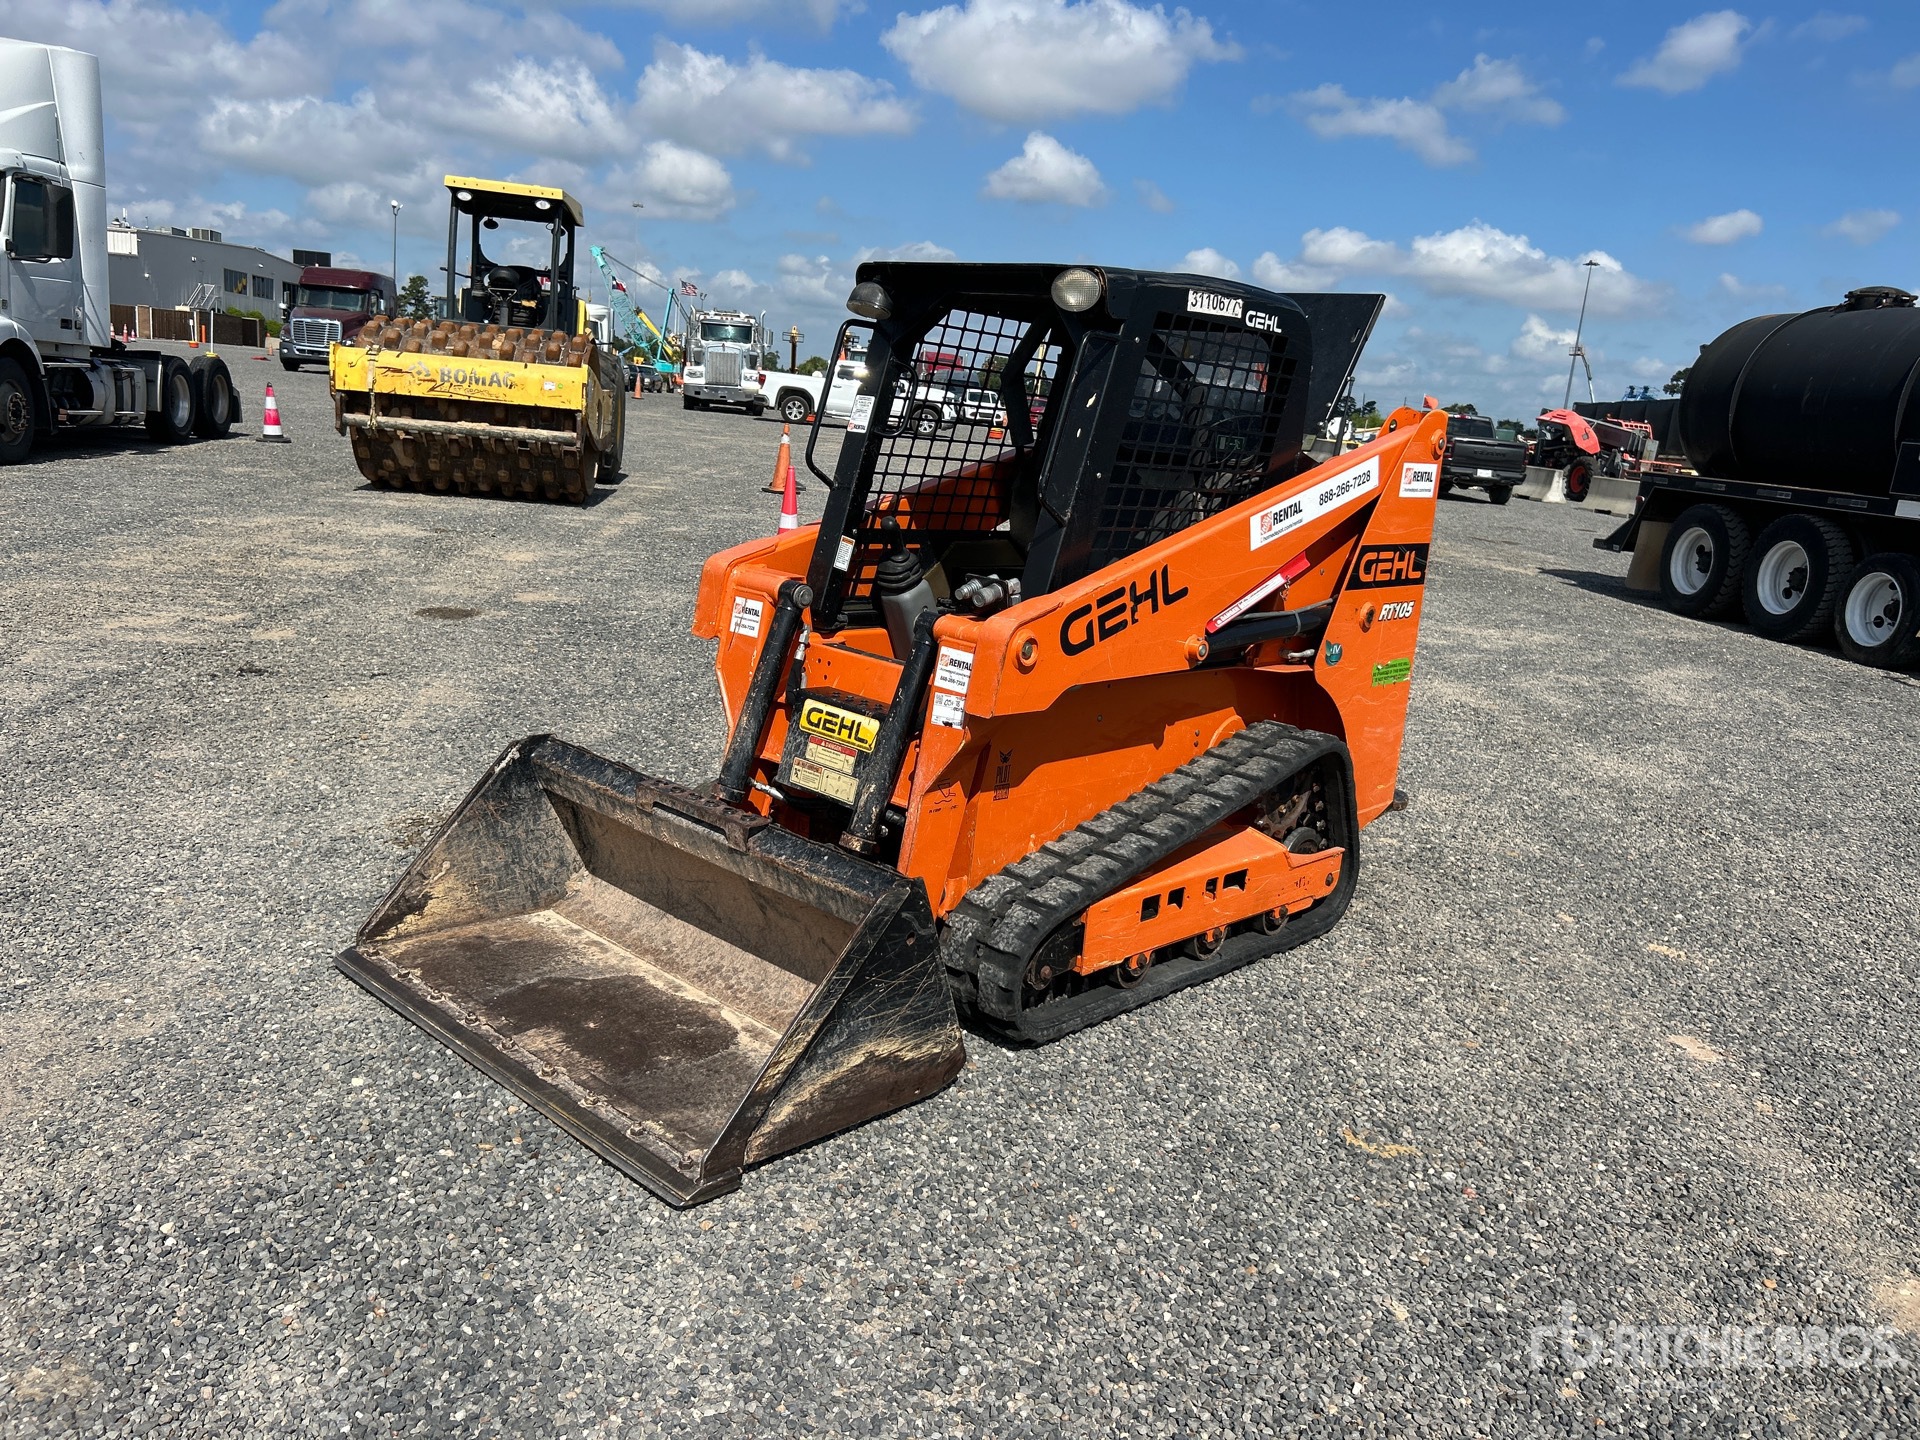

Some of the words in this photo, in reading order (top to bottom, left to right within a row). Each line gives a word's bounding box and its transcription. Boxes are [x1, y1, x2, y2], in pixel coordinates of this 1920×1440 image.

[1245, 310, 1282, 333] GEHL
[1412, 471, 1433, 482] RENTAL
[1272, 500, 1303, 526] RENTAL
[1318, 469, 1371, 506] 888-266-7228
[1359, 550, 1422, 583] GEHL
[742, 606, 760, 617] RENTAL
[1059, 563, 1189, 657] GEHL
[1377, 600, 1414, 621] RT105
[948, 658, 972, 671] RENTAL
[806, 706, 869, 745] GEHL
